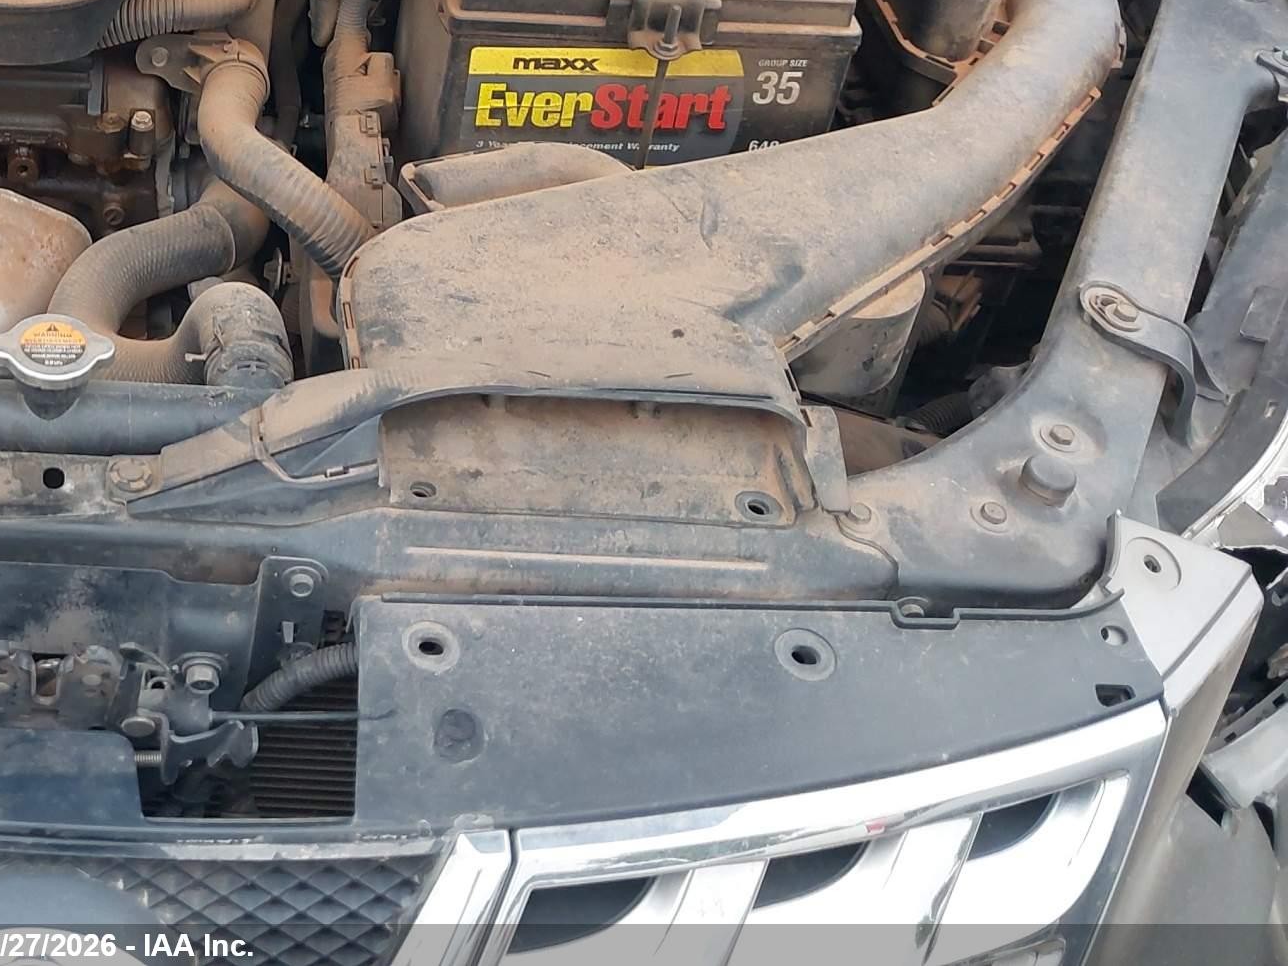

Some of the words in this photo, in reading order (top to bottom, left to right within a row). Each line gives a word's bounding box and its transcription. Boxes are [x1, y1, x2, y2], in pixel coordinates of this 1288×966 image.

[512, 57, 600, 72] maxx
[758, 58, 789, 67] GROUP
[789, 59, 809, 68] SIZE
[752, 70, 802, 105] 35
[475, 82, 730, 130] EverStart
